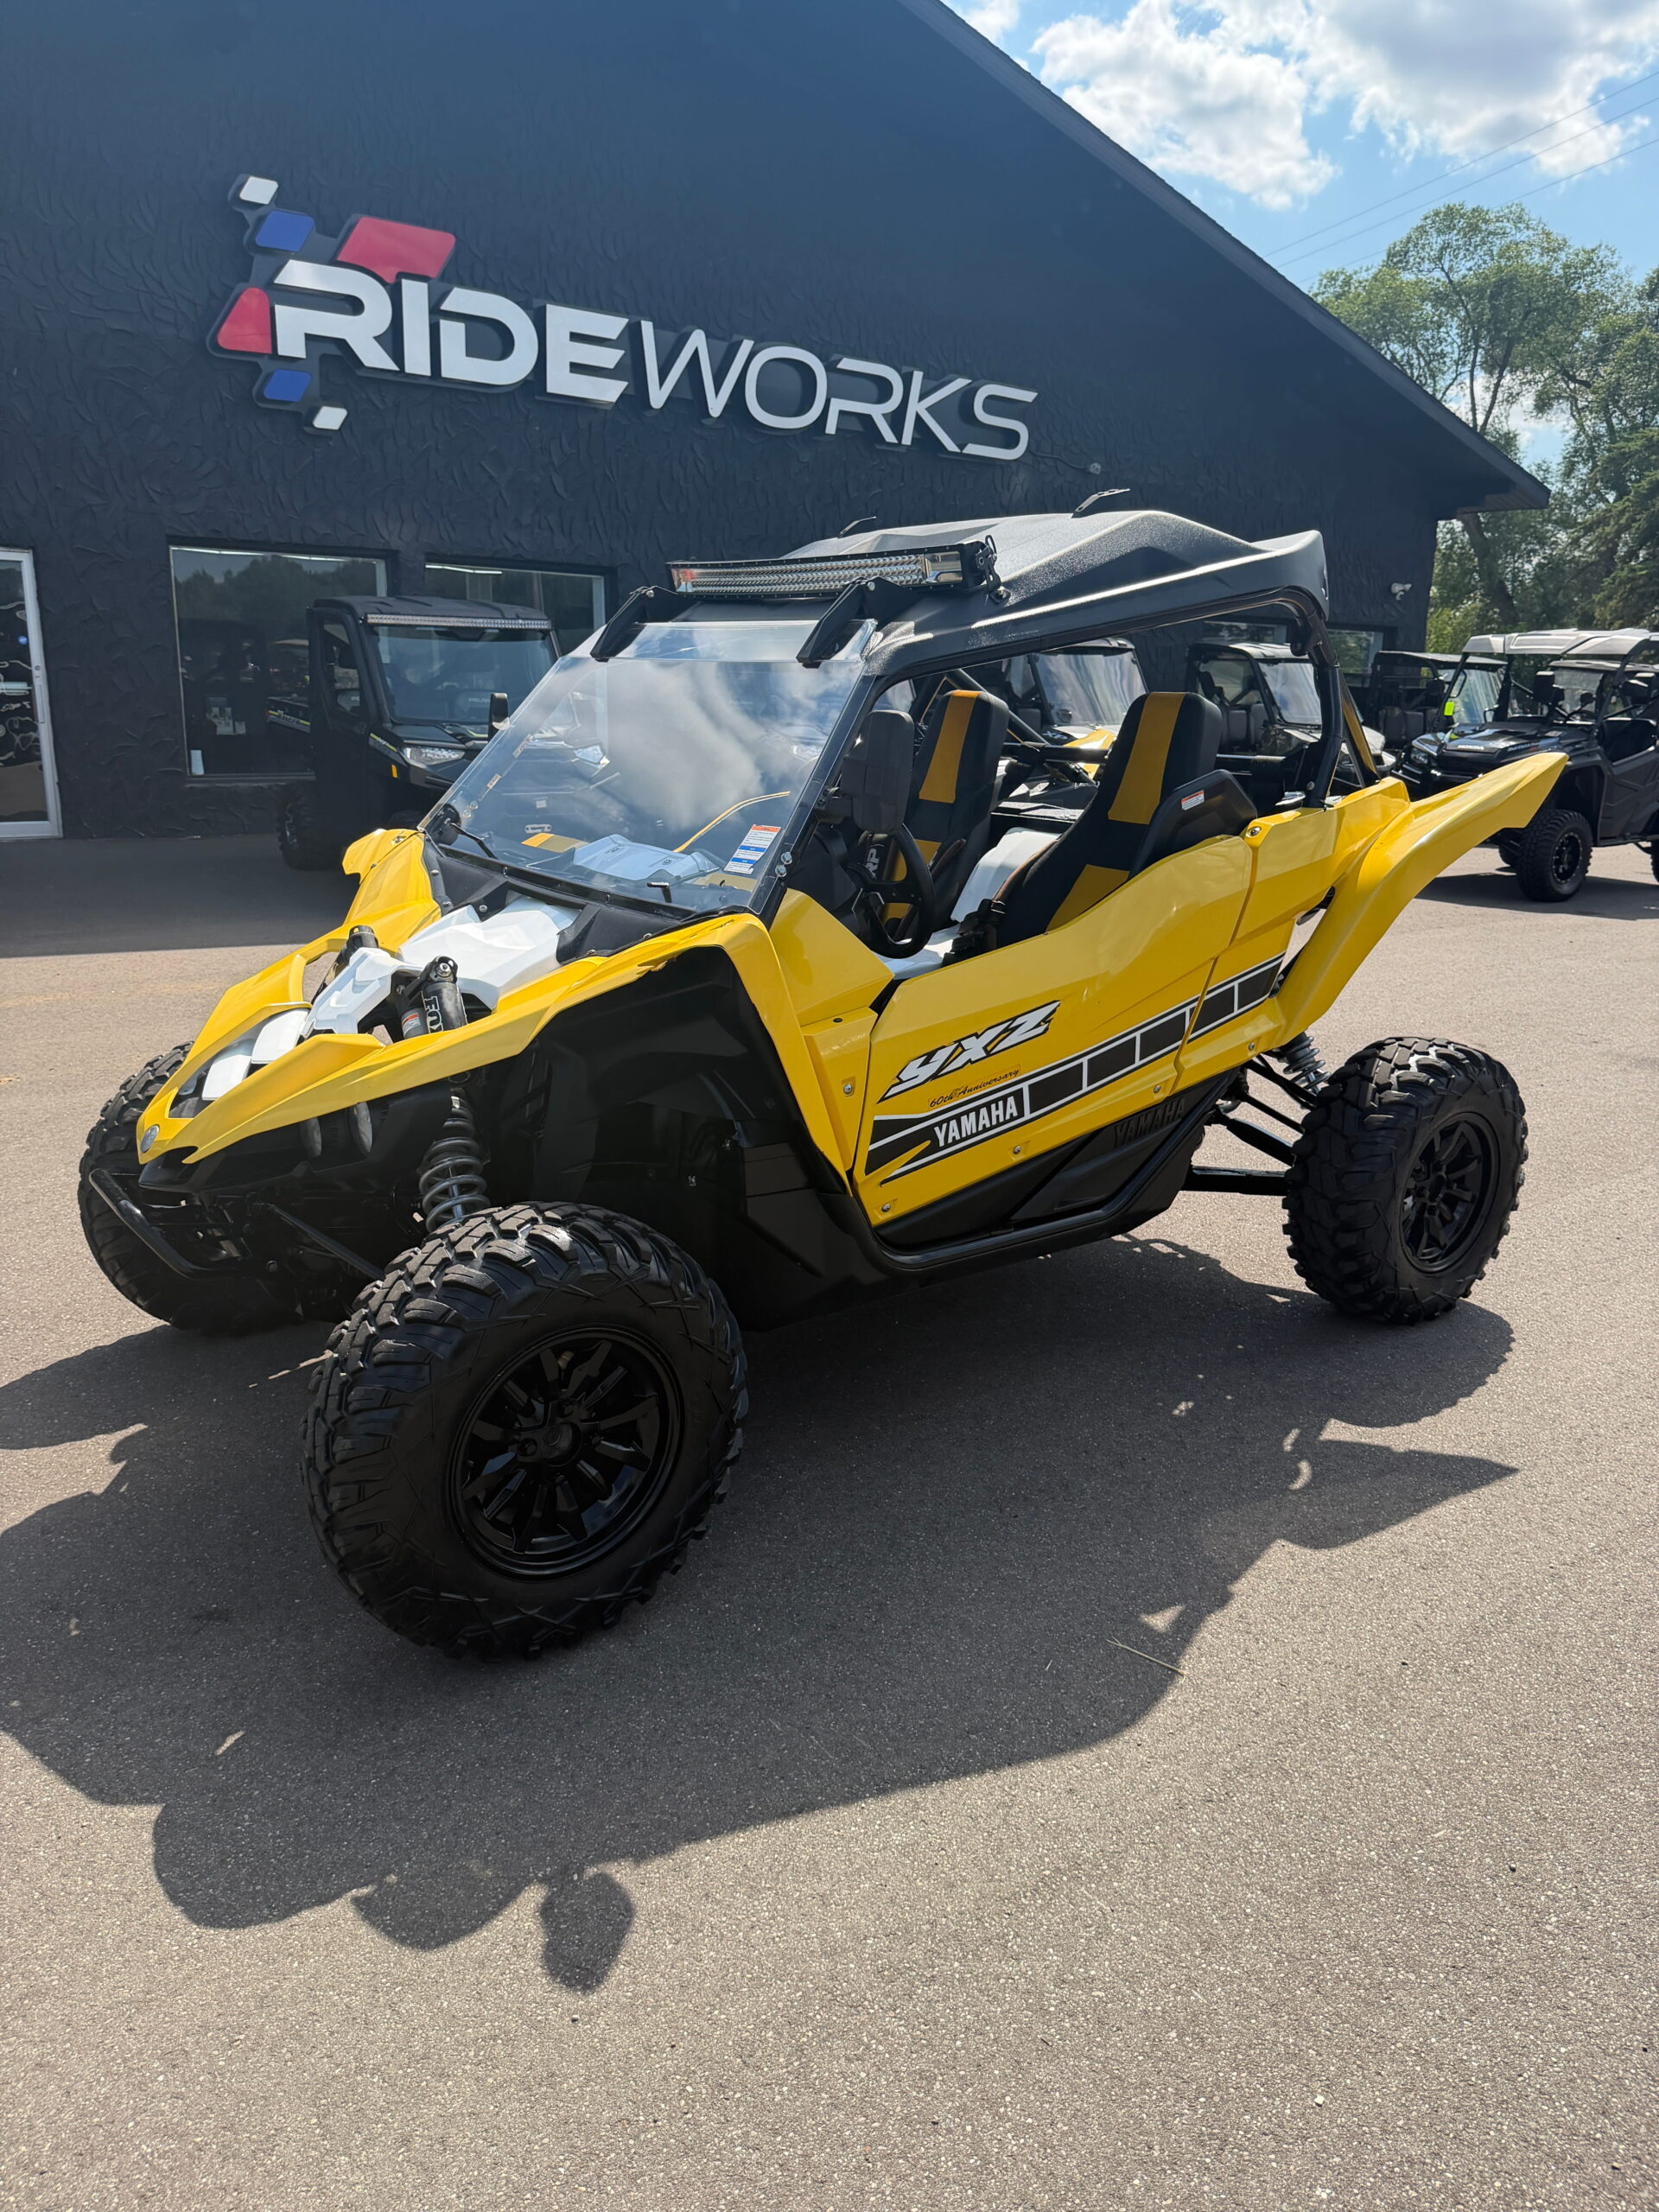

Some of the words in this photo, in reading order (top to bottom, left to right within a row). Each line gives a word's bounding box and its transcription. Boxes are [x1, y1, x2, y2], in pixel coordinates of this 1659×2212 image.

[273, 258, 1037, 461] RIDEWORKS
[877, 1000, 1061, 1104] YXZ
[929, 1094, 956, 1108] 60th
[957, 1069, 1020, 1097] Anniversary
[933, 1095, 1018, 1147] YAMAHA
[1115, 1096, 1185, 1148] YAMAHA
